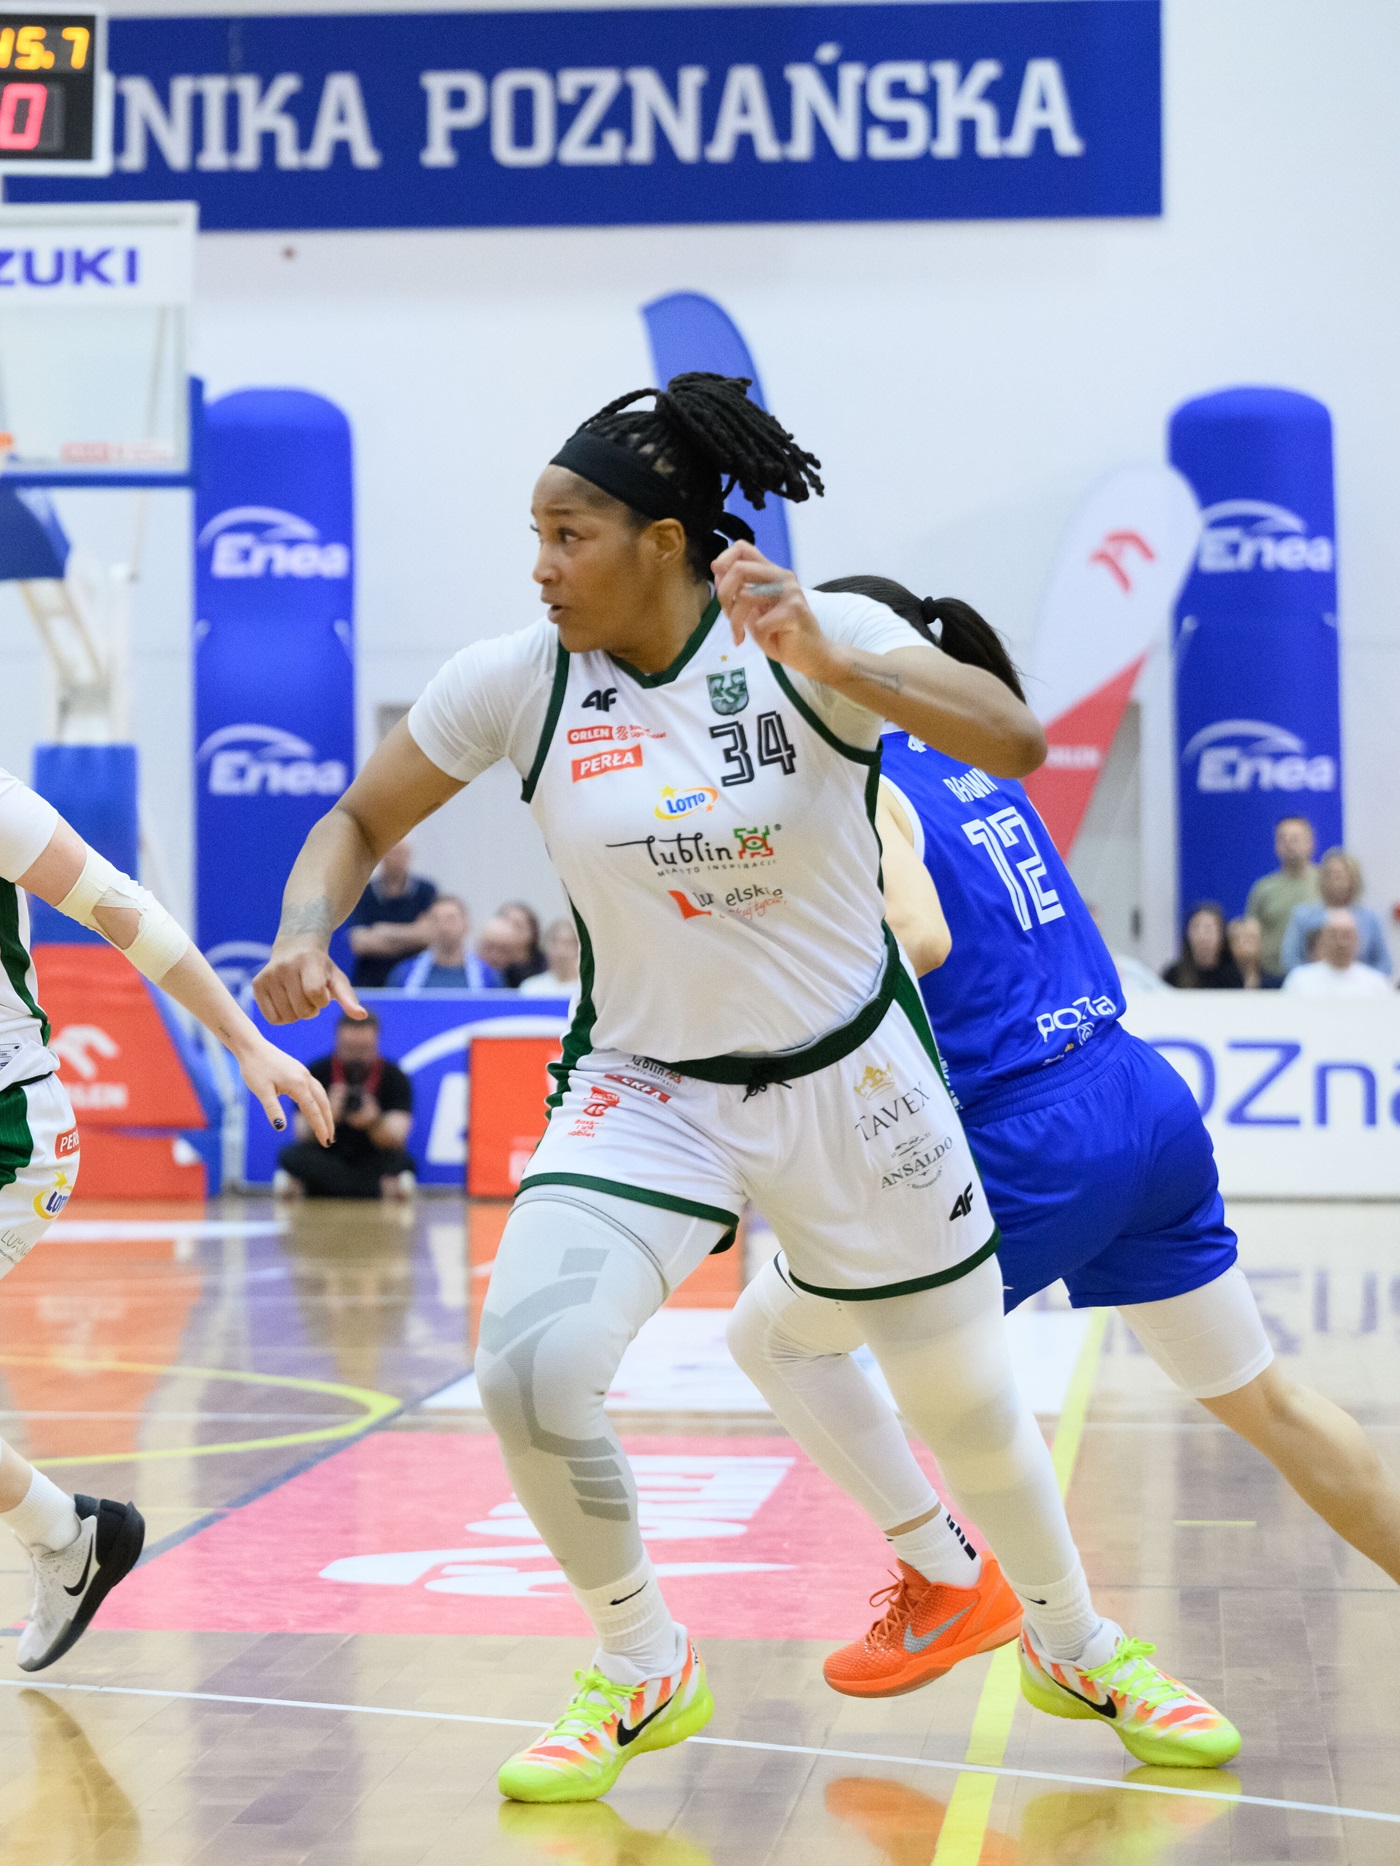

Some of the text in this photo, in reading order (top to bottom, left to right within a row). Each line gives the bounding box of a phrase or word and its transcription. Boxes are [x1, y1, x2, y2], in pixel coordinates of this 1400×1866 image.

[420, 43, 1084, 168] POZNAŃSKA
[211, 532, 349, 578] Enea
[1198, 527, 1333, 573] Enea
[581, 688, 617, 712] 4F
[570, 728, 610, 742] ORLEN
[709, 711, 796, 787] 34
[209, 750, 346, 796] Enea
[580, 754, 635, 776] PERŁA
[1198, 746, 1335, 793] Enea
[961, 806, 1066, 931] 12
[855, 1082, 930, 1141] TAVEX
[881, 1136, 953, 1189] ANSALDO
[949, 1182, 973, 1221] 4F
